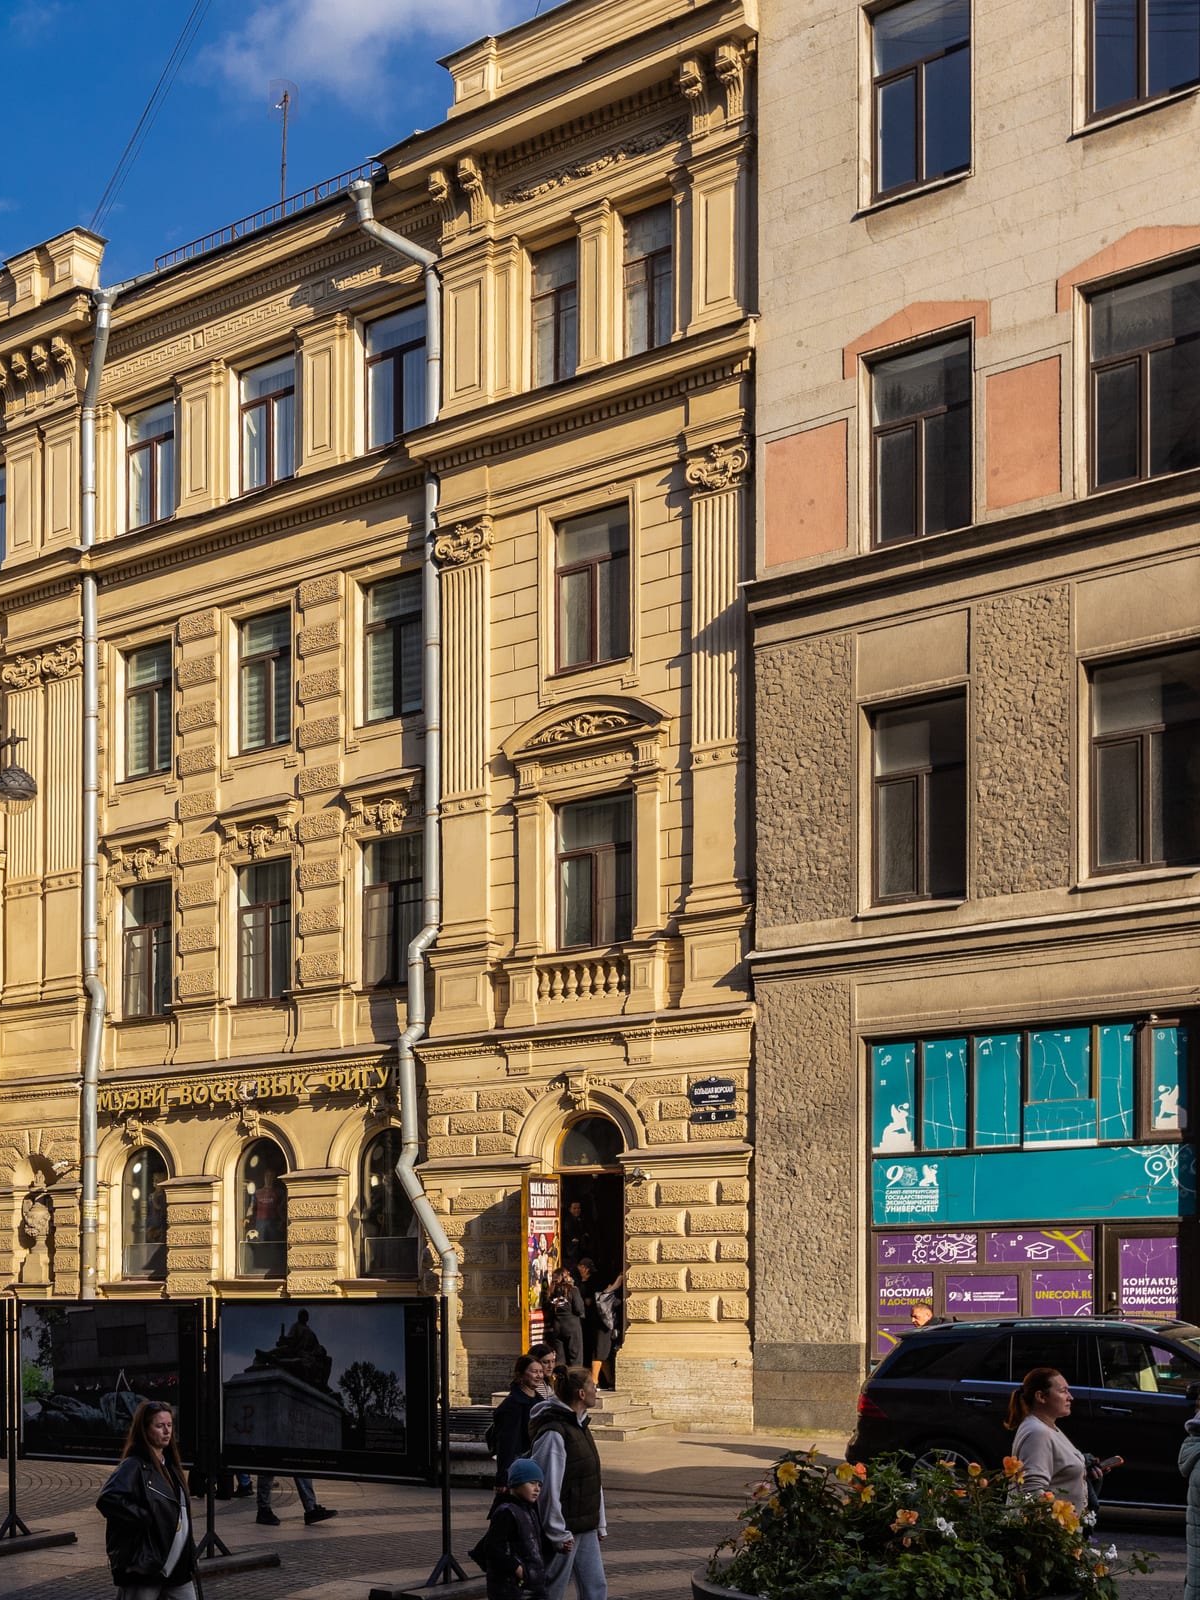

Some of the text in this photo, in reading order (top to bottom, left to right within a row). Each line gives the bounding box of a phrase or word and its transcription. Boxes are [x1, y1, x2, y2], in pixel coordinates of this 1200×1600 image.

[97, 1084, 166, 1112] МУЗЕЙ
[711, 1112, 716, 1120] 6
[1122, 1277, 1178, 1286] КОНТАКТЫ
[880, 1287, 933, 1297] ПОСТУПАЙ
[1122, 1286, 1178, 1295] ПРИЕМНОЙ
[1122, 1296, 1178, 1305] КОМИССИИ
